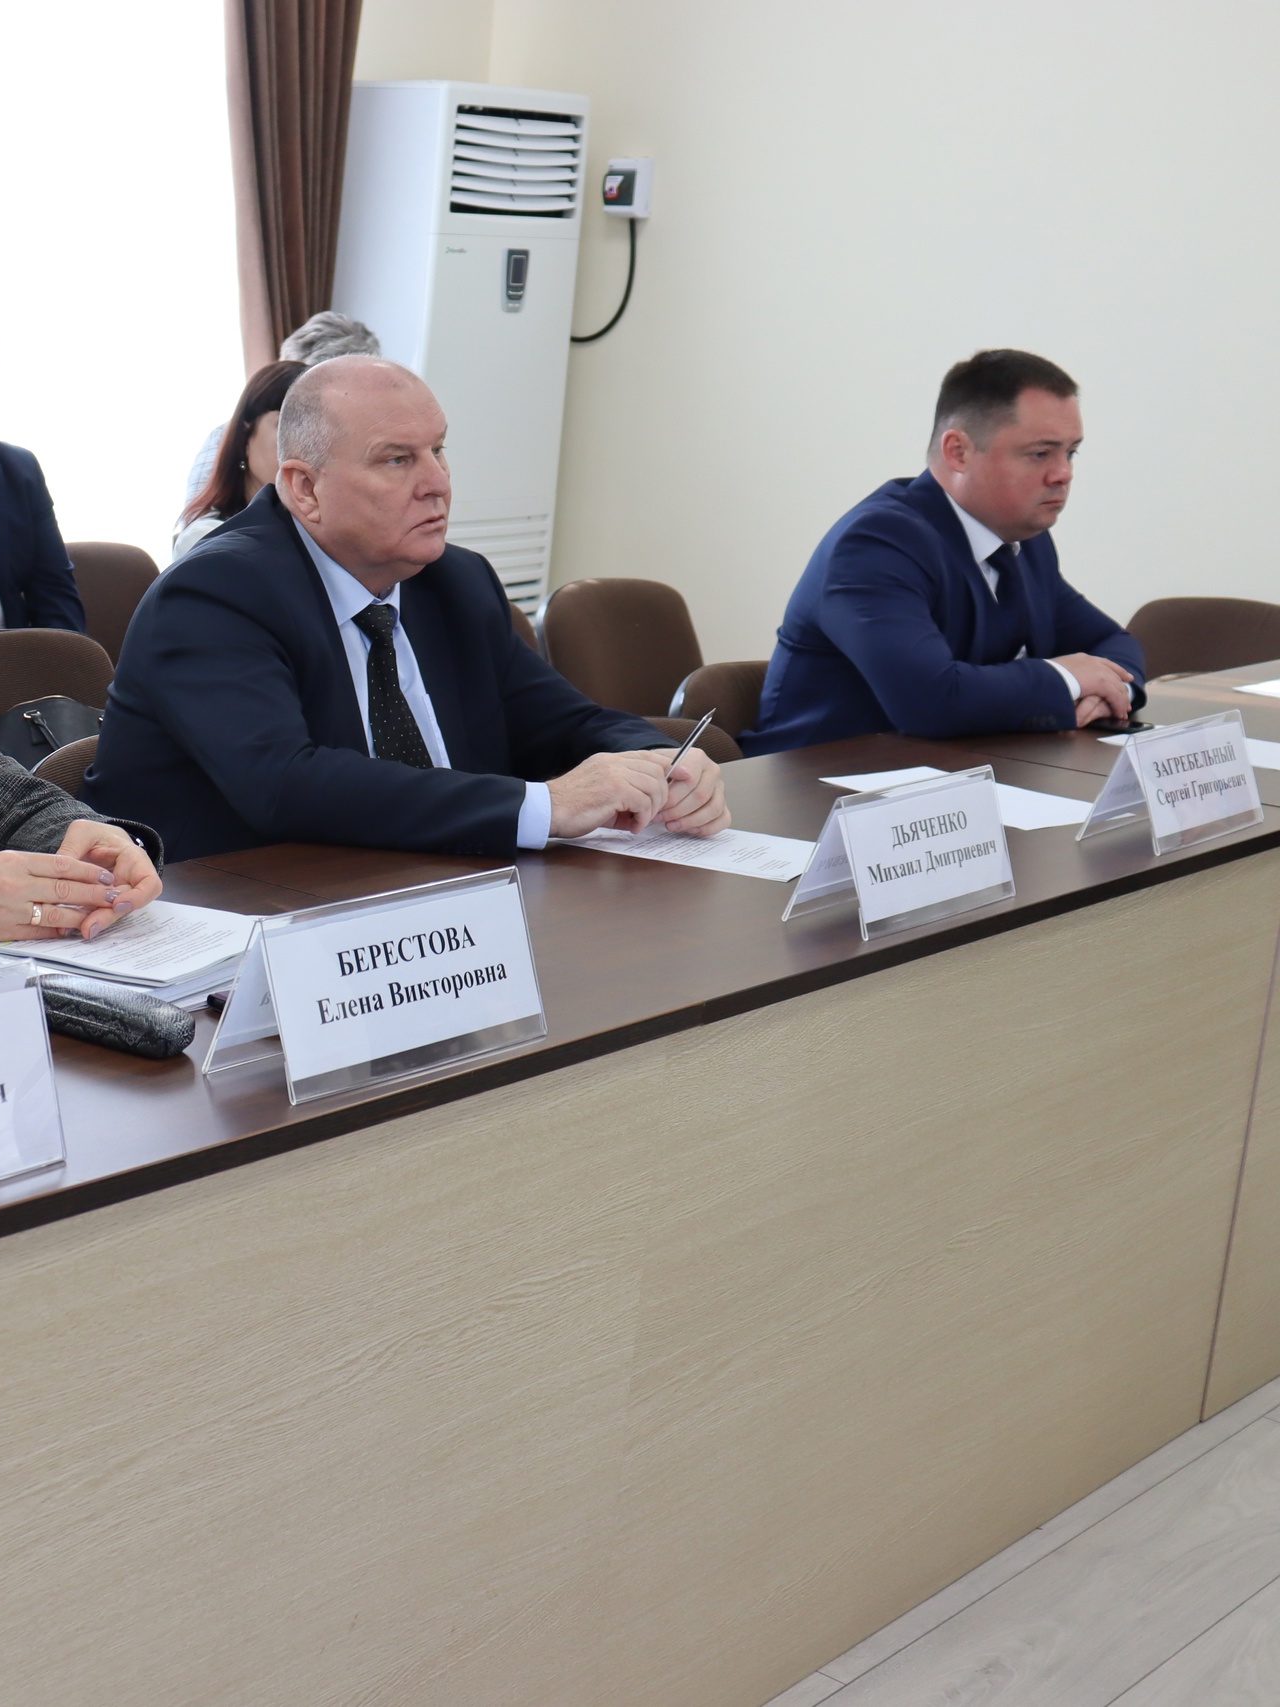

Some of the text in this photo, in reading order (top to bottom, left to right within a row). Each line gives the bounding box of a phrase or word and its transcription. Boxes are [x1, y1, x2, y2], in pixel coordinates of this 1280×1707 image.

[1153, 741, 1236, 778] ЗАГРЕБЕЛЬНЫЙ
[1156, 784, 1190, 808] Сергей
[1191, 774, 1247, 801] Григорьевич
[891, 810, 967, 849] ДЬЯЧЕНКО
[867, 858, 922, 885] Михаил
[925, 840, 997, 873] Дмитриевич
[336, 924, 476, 977] БЕРЕСТОВА
[316, 992, 384, 1025] Елена
[387, 963, 507, 1009] Викторовна
